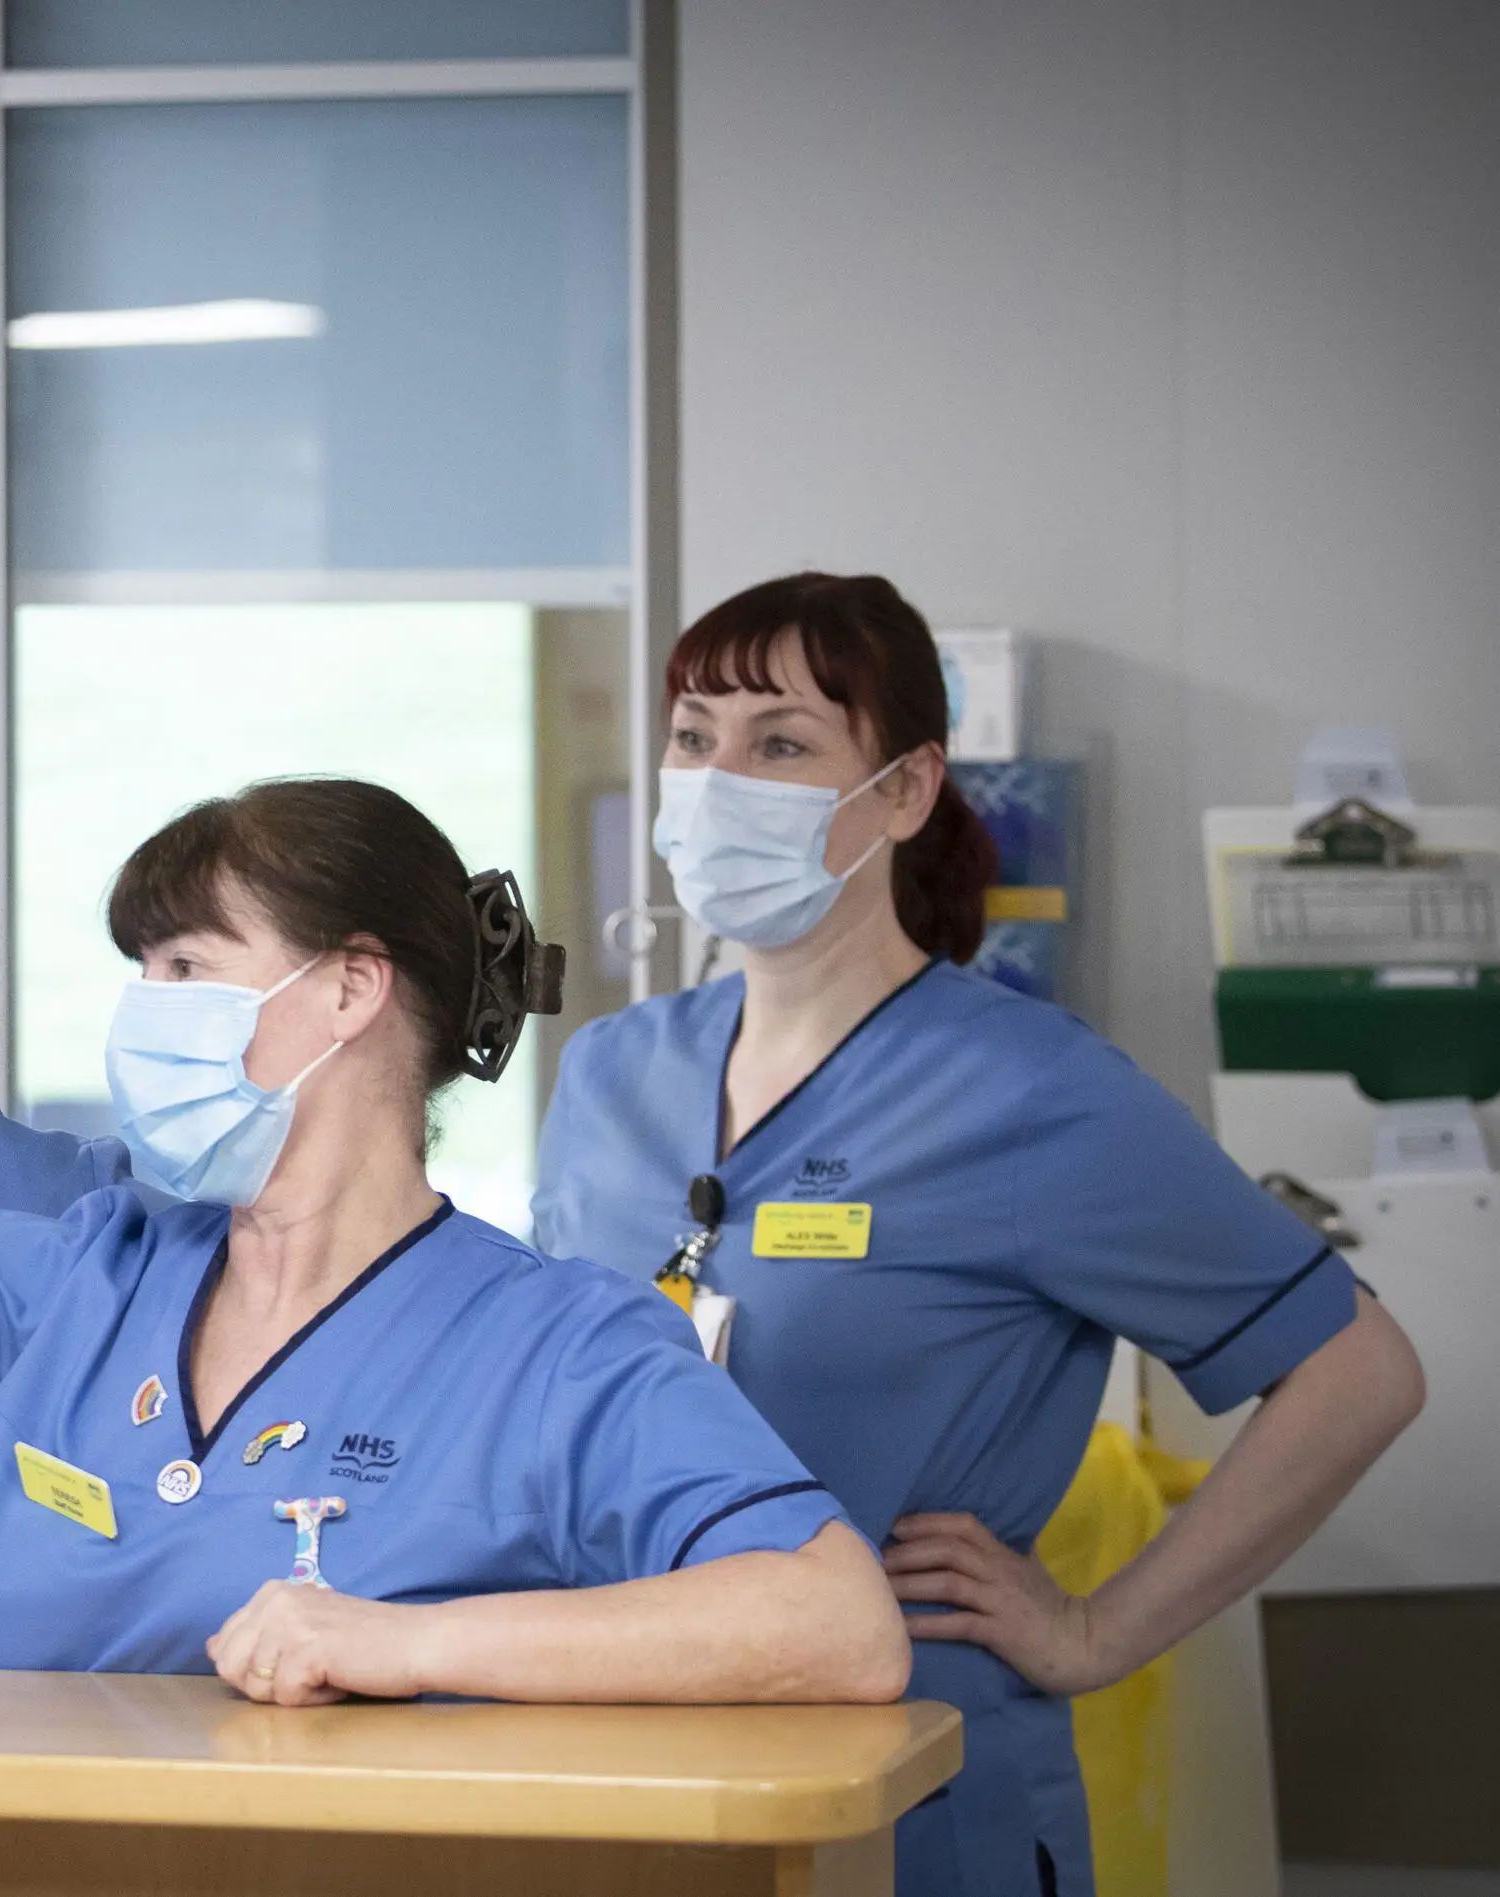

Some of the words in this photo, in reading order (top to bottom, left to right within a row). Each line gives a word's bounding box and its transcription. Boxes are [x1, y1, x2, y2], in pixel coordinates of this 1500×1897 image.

[802, 1157, 849, 1178] NHS
[339, 1432, 397, 1459] NHS
[159, 1472, 192, 1497] NHS
[329, 1467, 389, 1484] SCOTLAND
